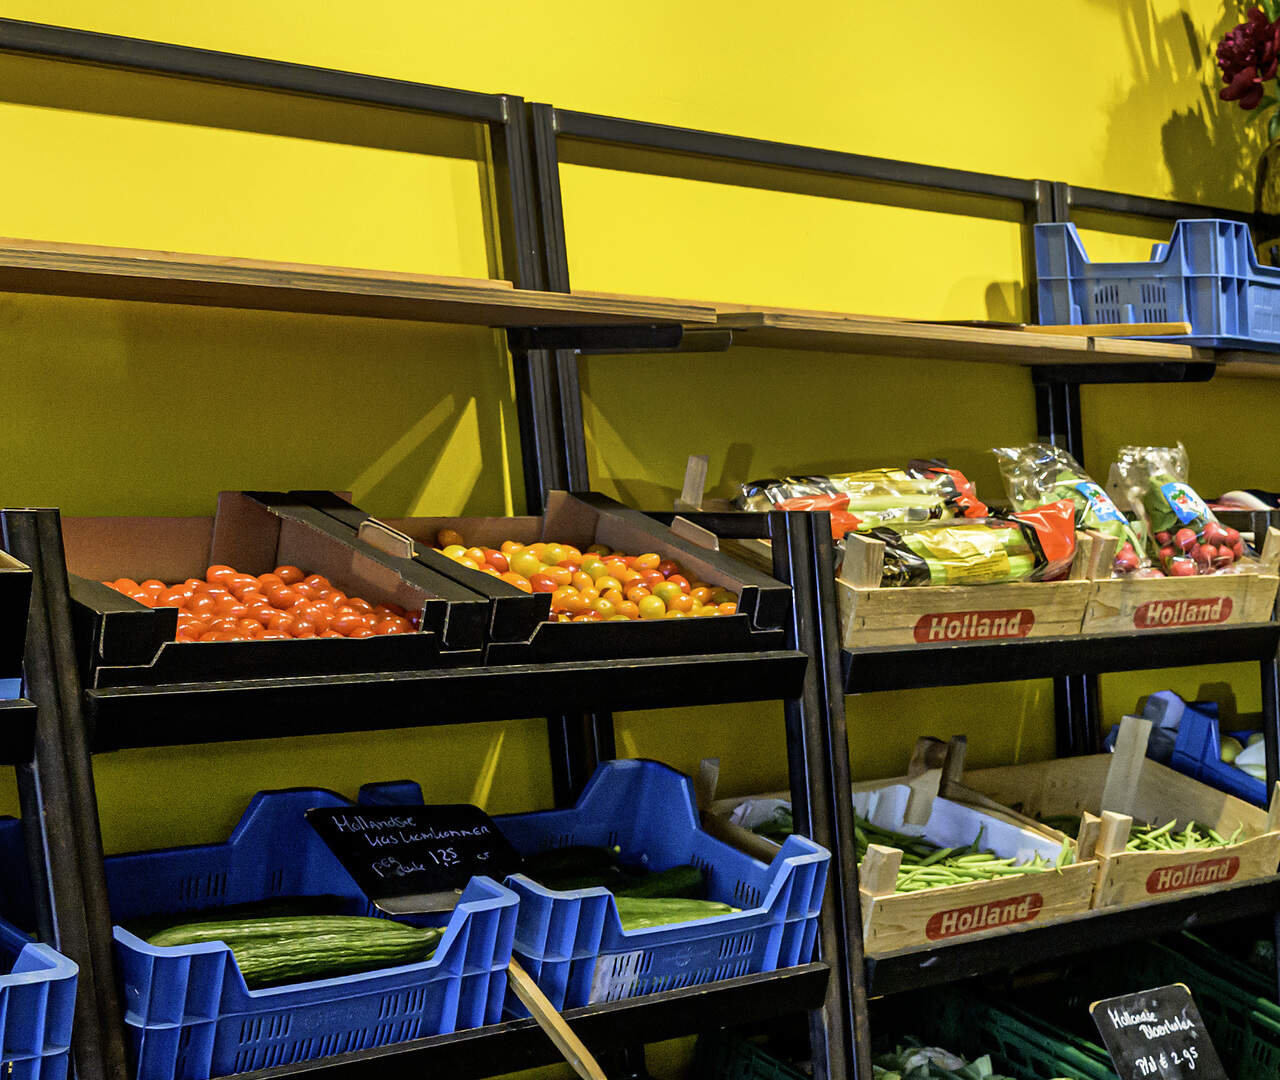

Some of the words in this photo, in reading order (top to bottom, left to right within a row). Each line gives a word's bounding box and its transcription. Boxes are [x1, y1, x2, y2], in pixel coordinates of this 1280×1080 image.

[929, 610, 1021, 641] Holland
[1145, 598, 1223, 626] Holland
[1157, 858, 1230, 891] Holland
[940, 897, 1030, 934] Holland
